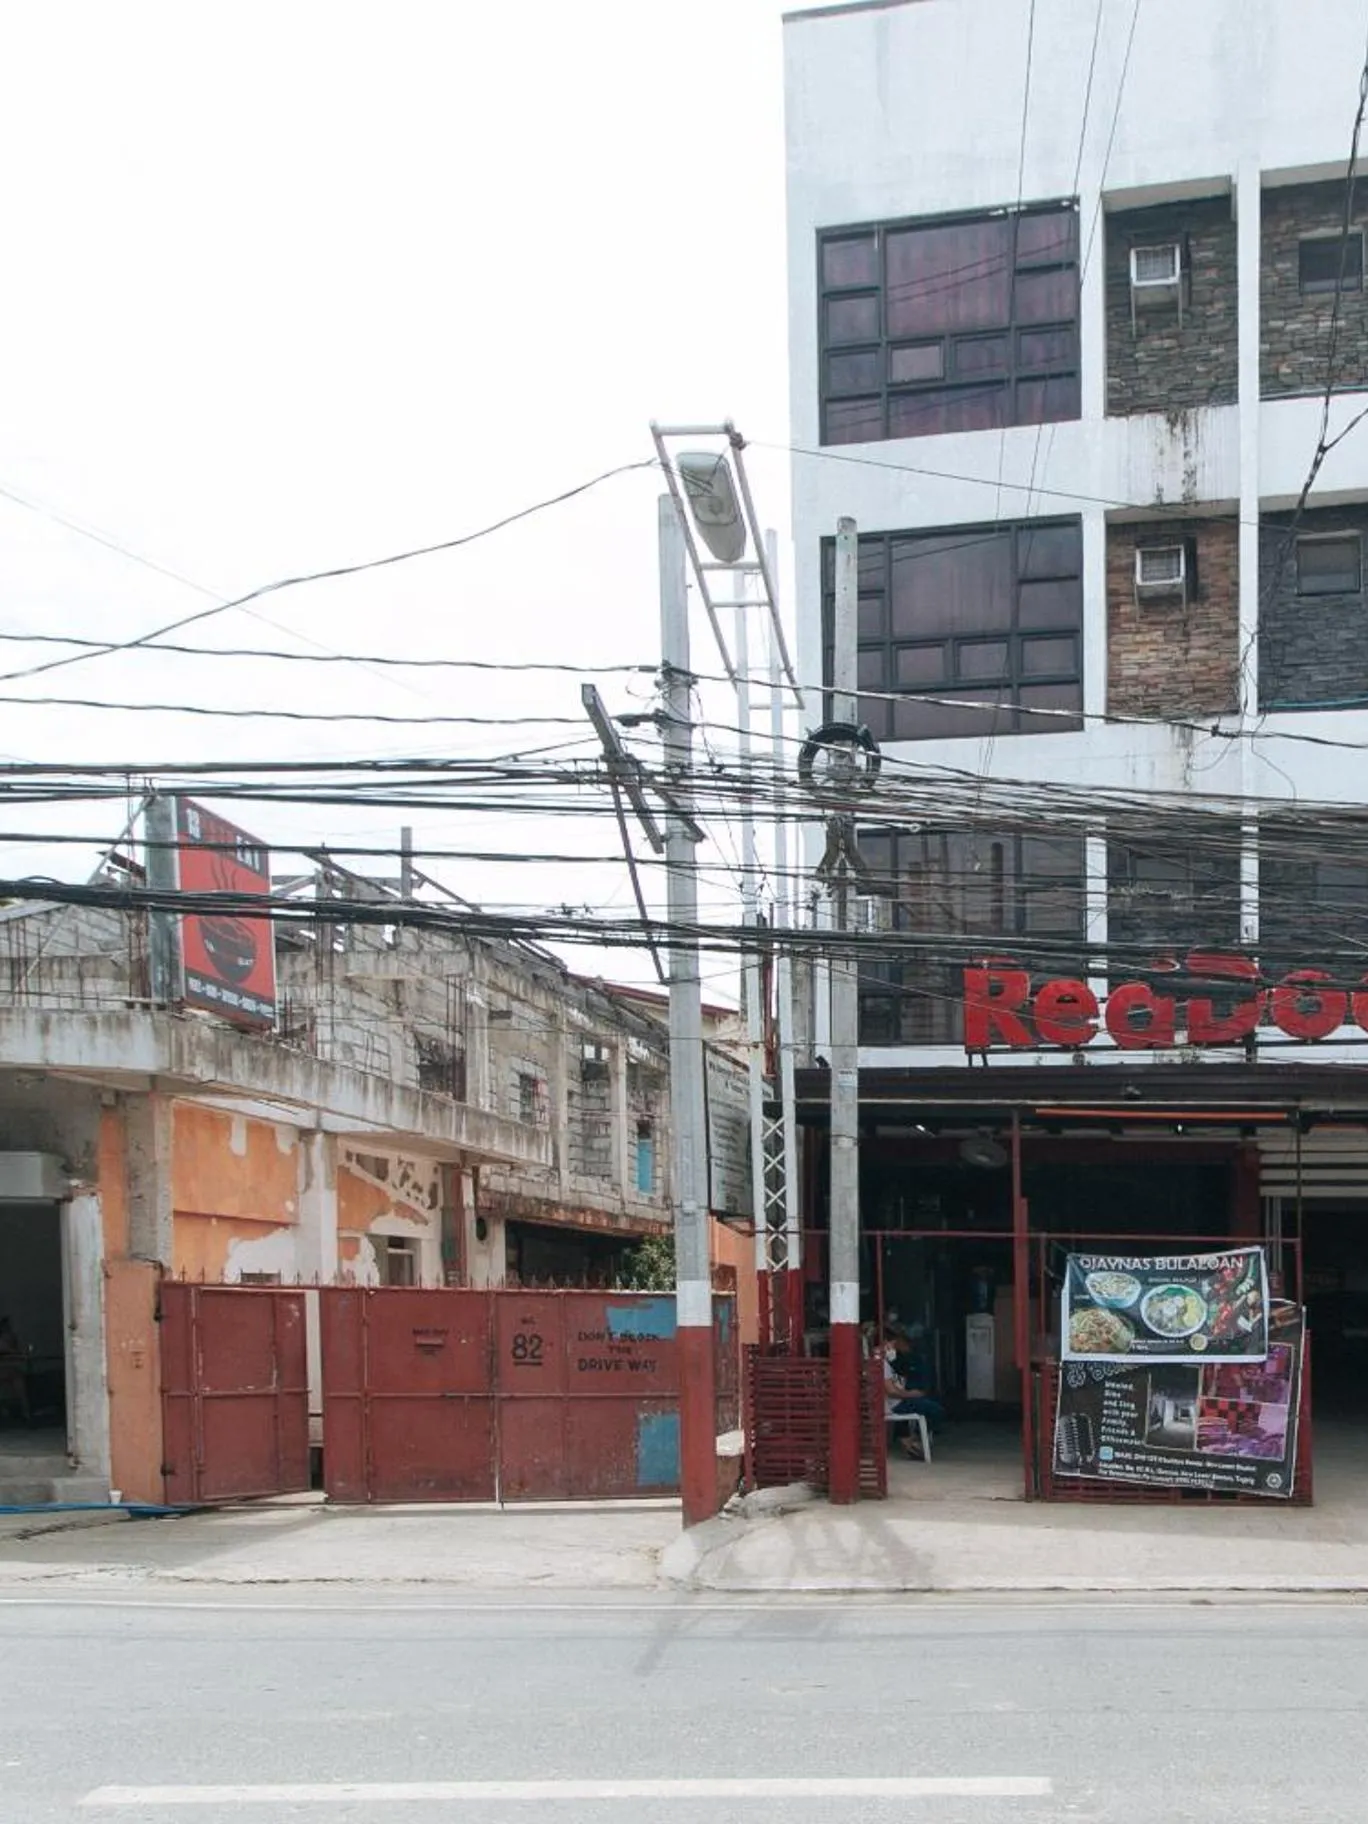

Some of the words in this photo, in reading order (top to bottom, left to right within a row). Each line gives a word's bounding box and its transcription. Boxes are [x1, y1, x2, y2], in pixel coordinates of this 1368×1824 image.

[1155, 1255, 1244, 1271] BULALOAN
[512, 1333, 544, 1361] 82
[577, 1358, 625, 1373] DRIVE
[627, 1358, 658, 1373] WAY
